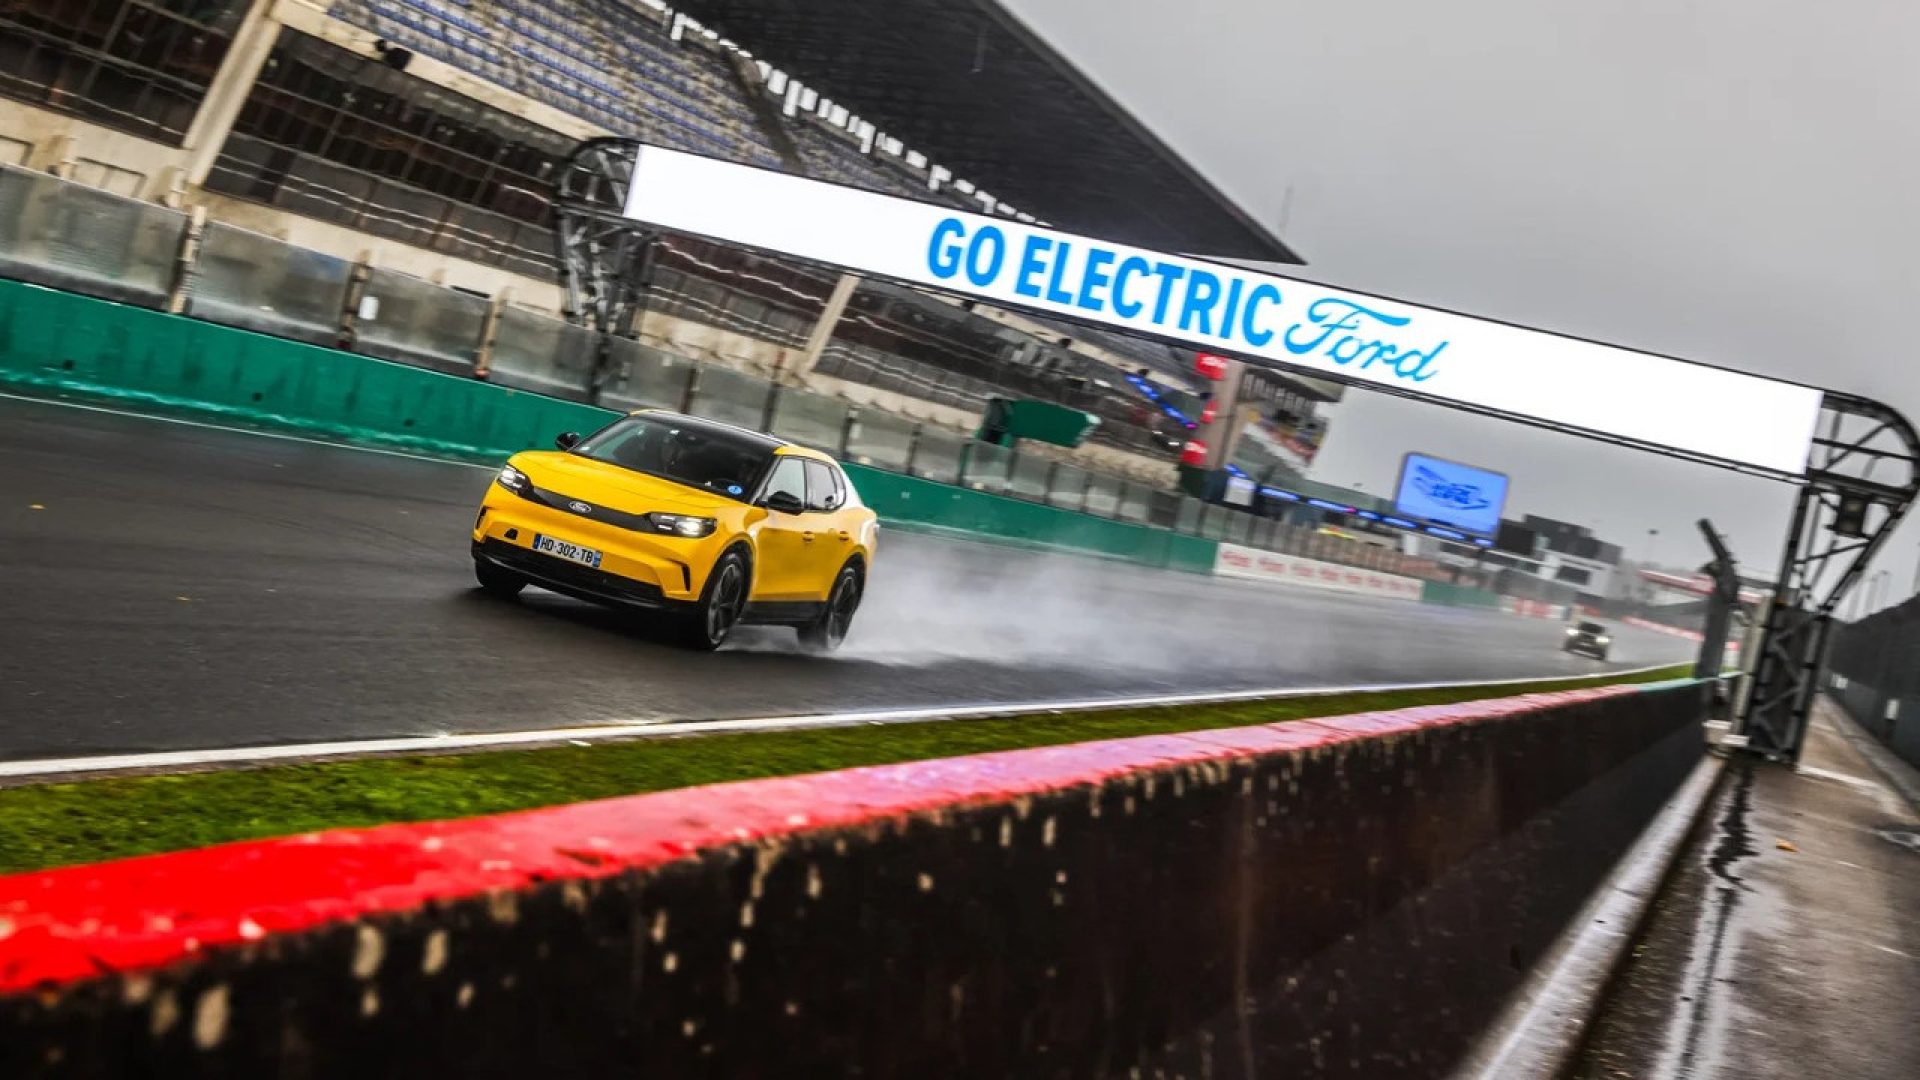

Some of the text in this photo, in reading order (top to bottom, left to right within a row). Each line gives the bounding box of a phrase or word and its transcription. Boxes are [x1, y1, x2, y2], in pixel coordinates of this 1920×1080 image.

[926, 217, 1448, 383] GO ELECTRIC Ford
[540, 537, 593, 563] HD-302-TB
